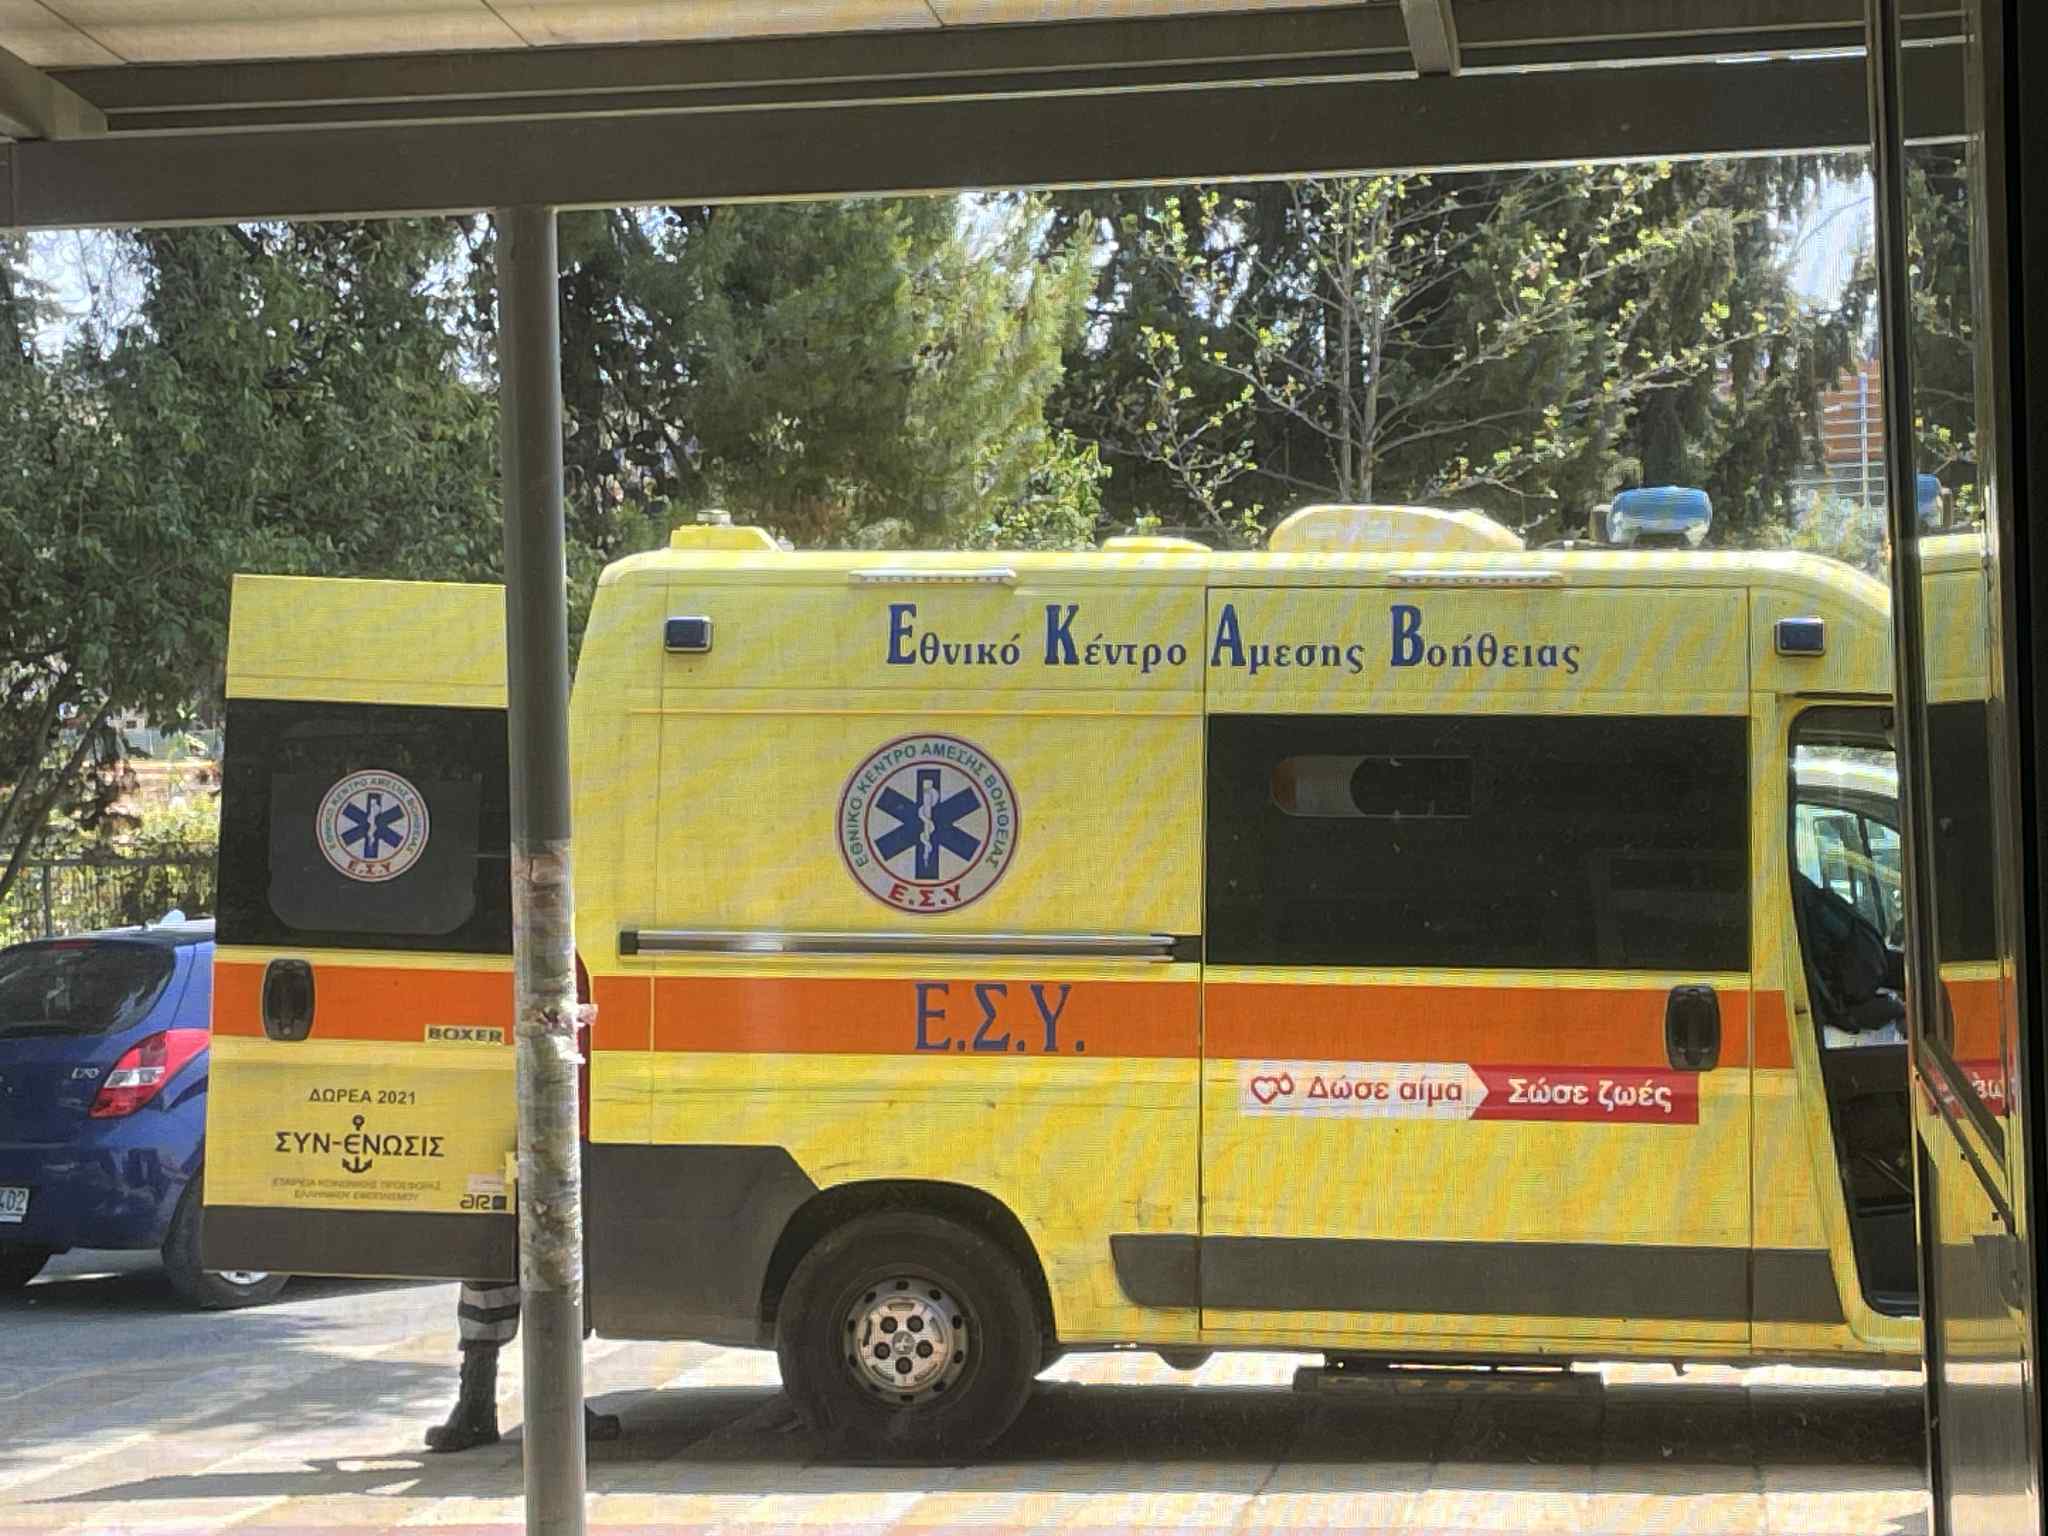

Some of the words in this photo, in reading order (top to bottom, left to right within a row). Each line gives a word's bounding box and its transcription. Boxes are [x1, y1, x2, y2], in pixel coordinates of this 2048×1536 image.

[887, 603, 1021, 666] Εθνικό
[1044, 604, 1187, 675] Κέντρο
[1210, 604, 1365, 675] Αμεσης
[1390, 605, 1581, 675] Βοήθειας
[857, 744, 916, 797] ΚΕΝΤΡΟ
[427, 1027, 503, 1042] BOXER
[915, 983, 1085, 1052] Ε.Σ.Υ.
[309, 1088, 371, 1104] ΔΩΡΕΑ
[377, 1090, 416, 1105] 2021
[1307, 1076, 1389, 1101] Δώσε
[1399, 1076, 1463, 1108] αίμα
[1508, 1077, 1590, 1105] Σώσε
[1597, 1077, 1673, 1113] ζωές
